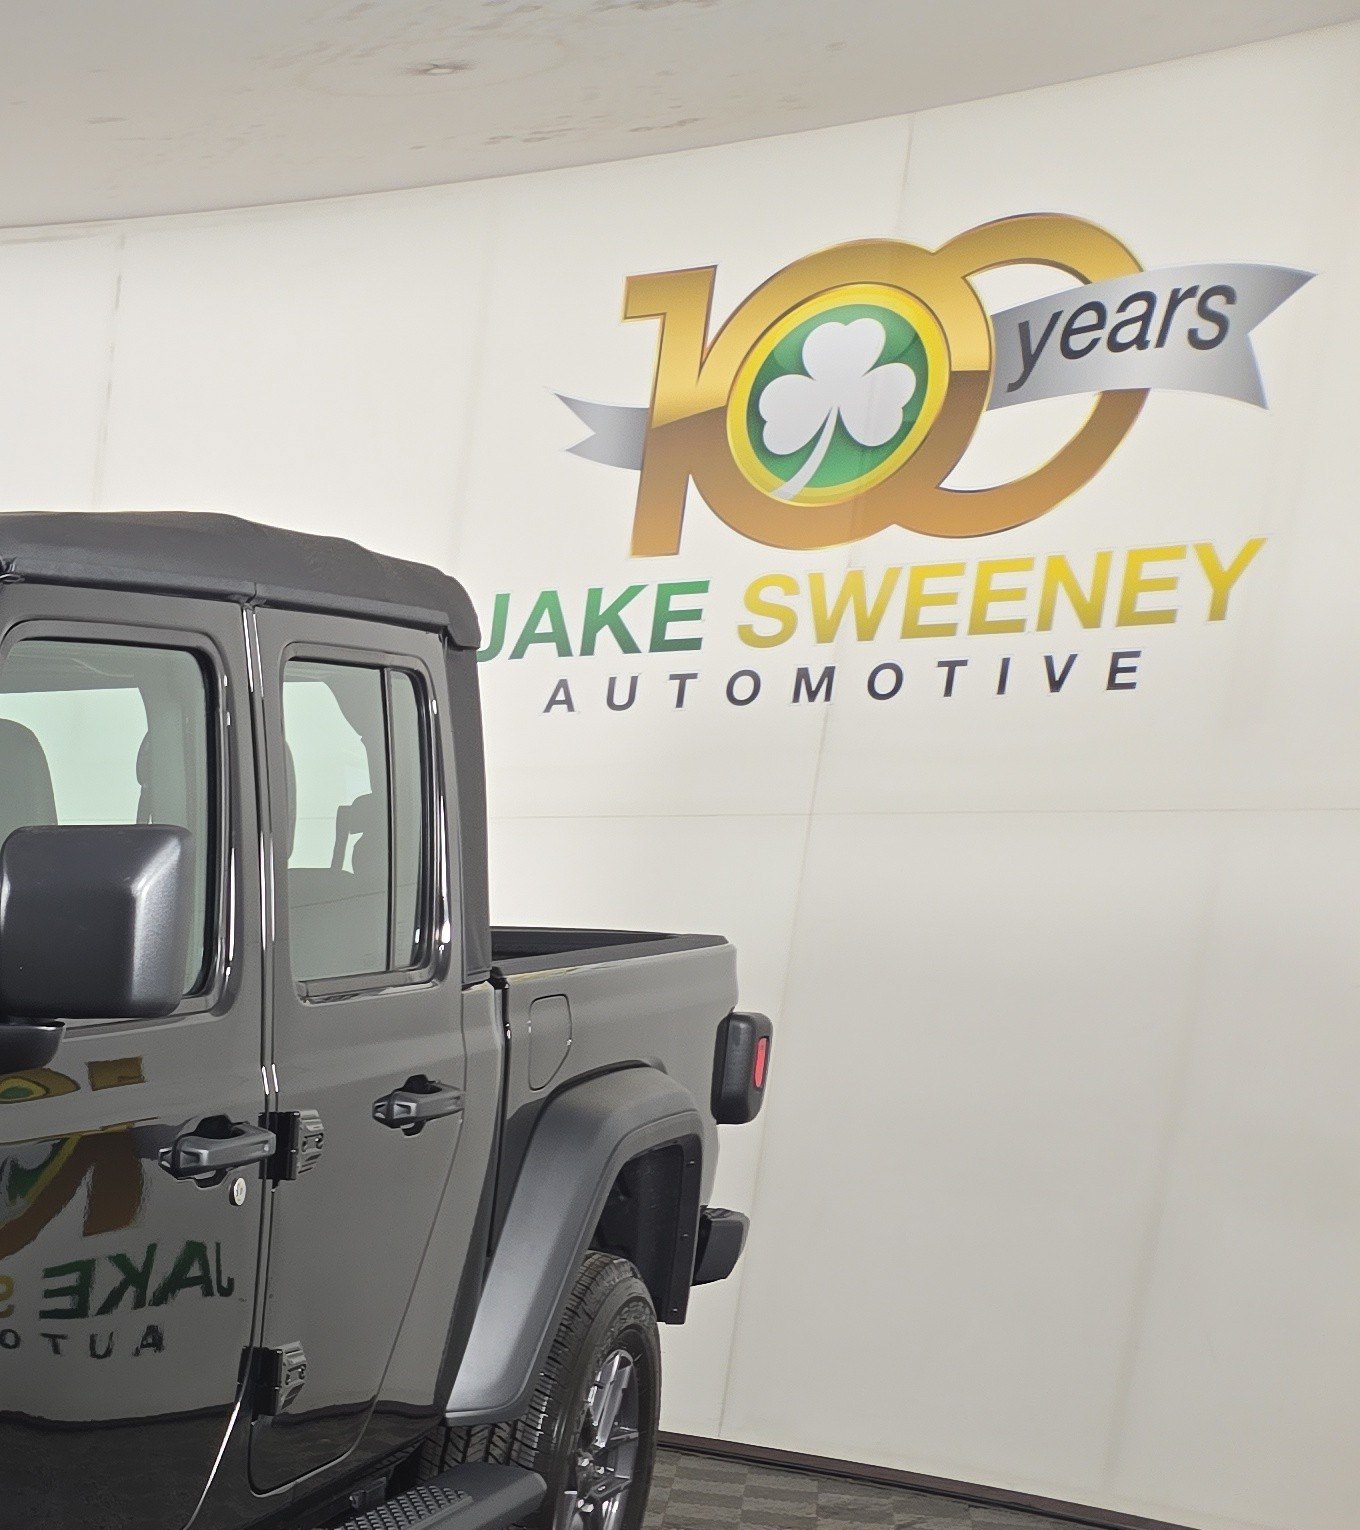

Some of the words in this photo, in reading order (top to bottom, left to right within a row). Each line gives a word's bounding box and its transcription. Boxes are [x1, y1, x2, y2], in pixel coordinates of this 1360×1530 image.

[623, 211, 1150, 558] 100
[1006, 283, 1237, 392] years
[476, 579, 710, 663] JAKE
[736, 537, 1268, 649] SWEENEY
[542, 649, 1143, 714] AUTOMOTIVE
